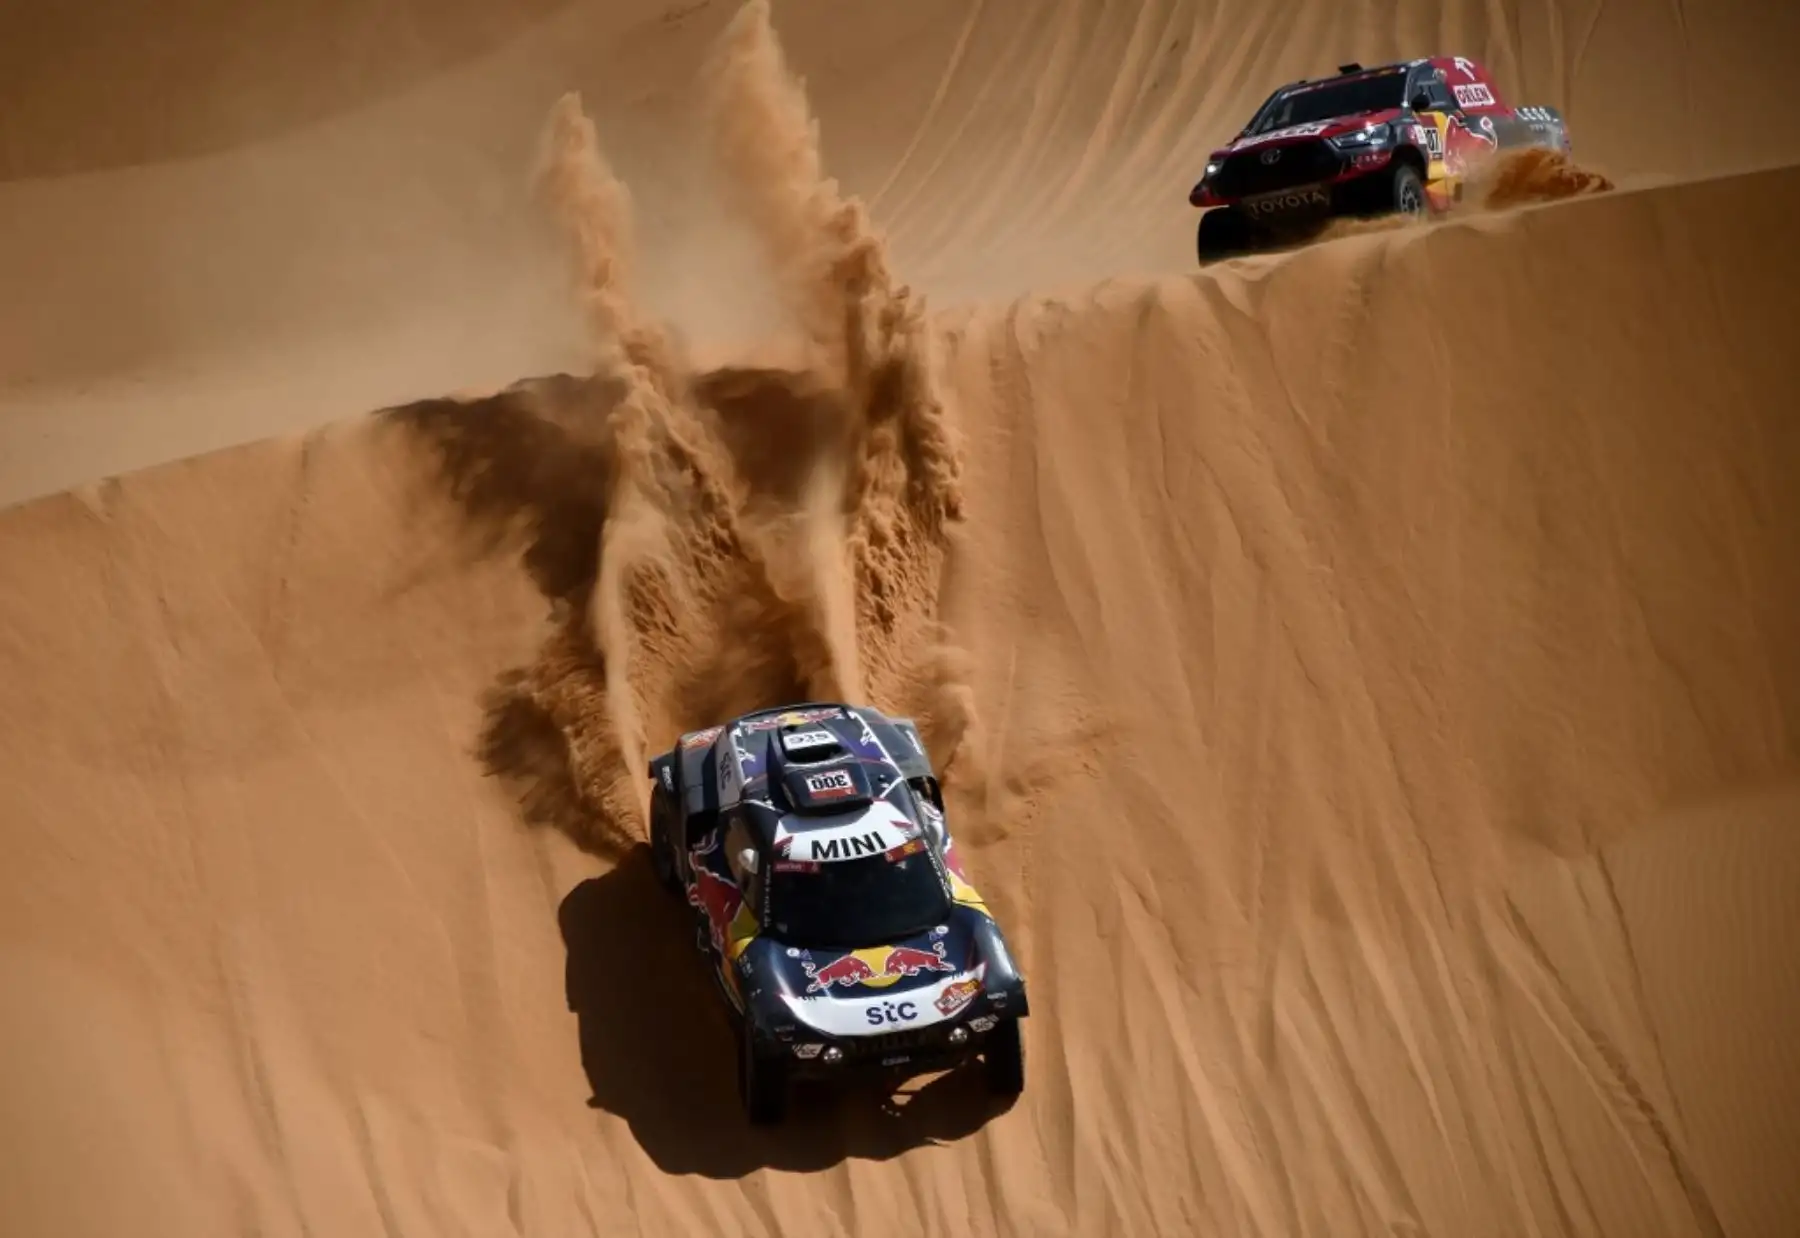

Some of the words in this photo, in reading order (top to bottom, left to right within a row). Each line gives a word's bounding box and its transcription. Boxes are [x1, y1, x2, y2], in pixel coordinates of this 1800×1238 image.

[1455, 88, 1491, 104] ORLEN
[1249, 191, 1325, 214] TOYOTA
[811, 831, 887, 860] MINI
[866, 1001, 918, 1025] stc
